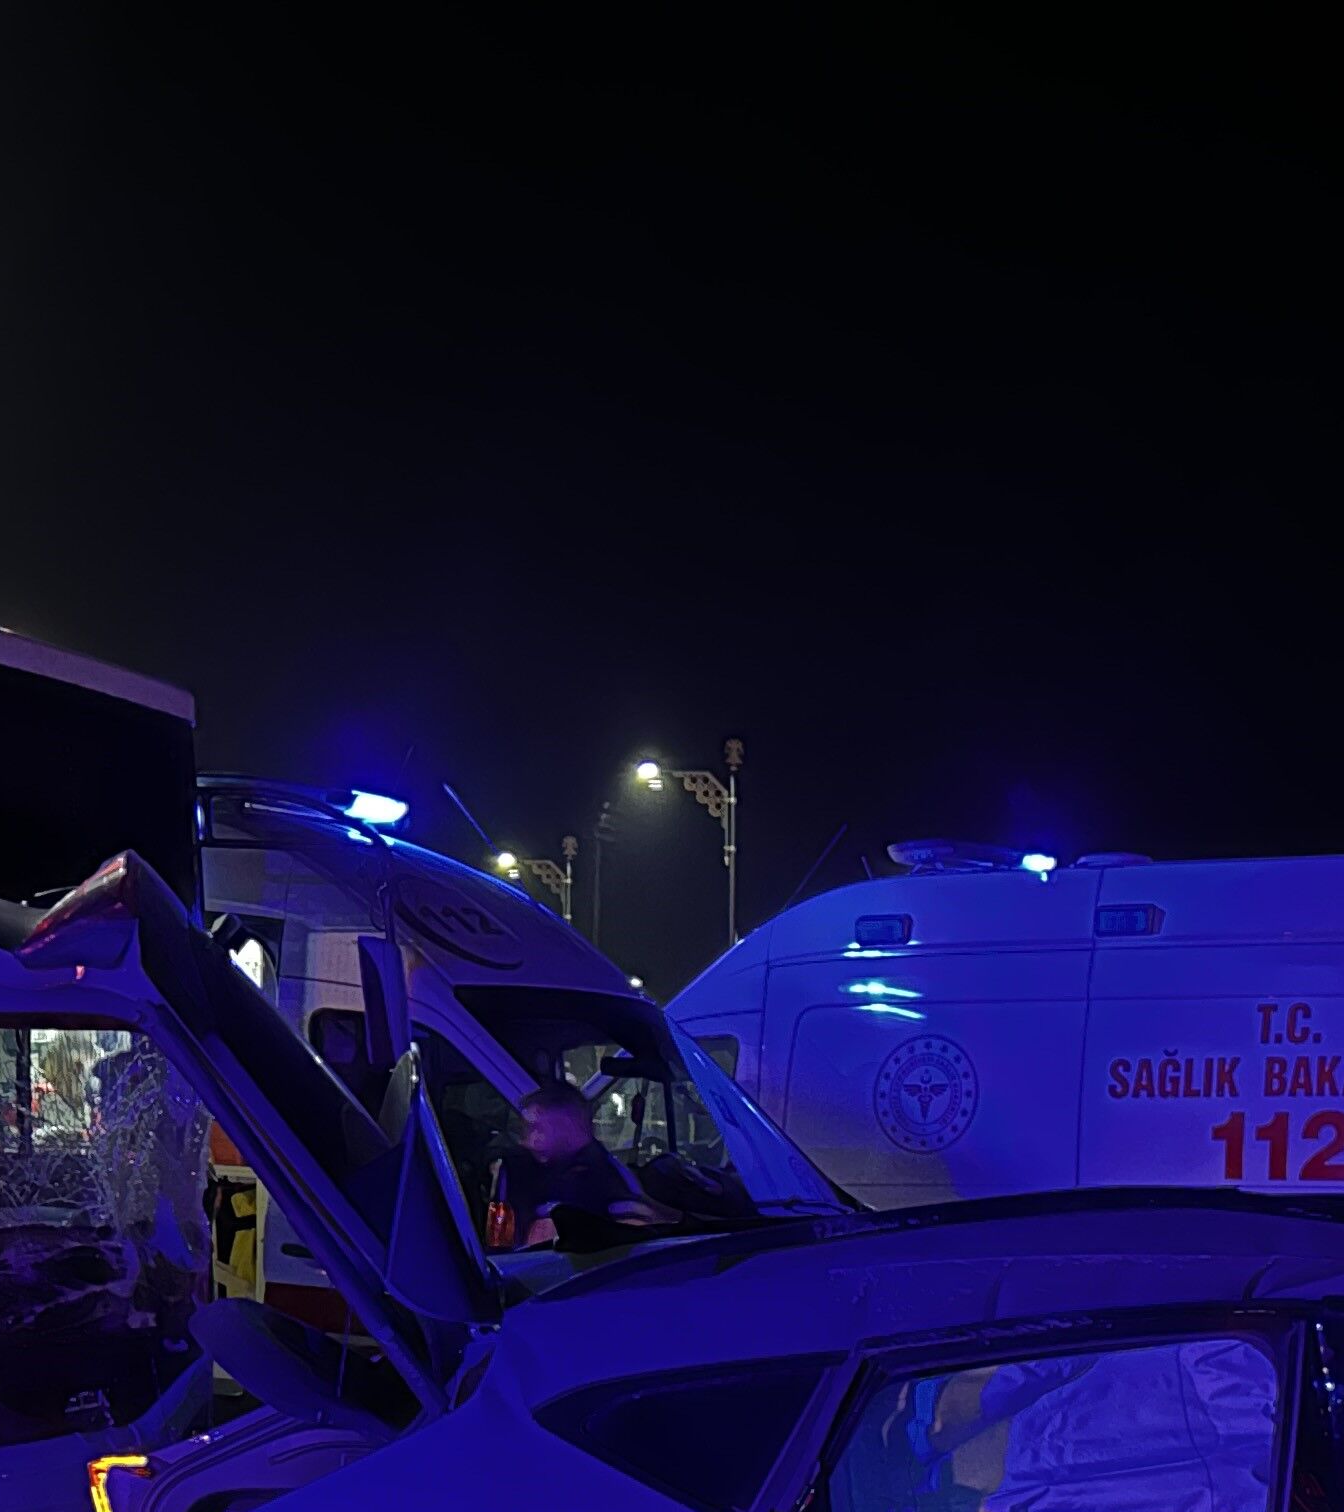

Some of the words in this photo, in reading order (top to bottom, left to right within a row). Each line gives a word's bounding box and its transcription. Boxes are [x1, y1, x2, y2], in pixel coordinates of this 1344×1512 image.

[419, 905, 505, 934] 112
[1257, 1002, 1323, 1044] T.C.
[1108, 1048, 1241, 1099] SAĞLIK
